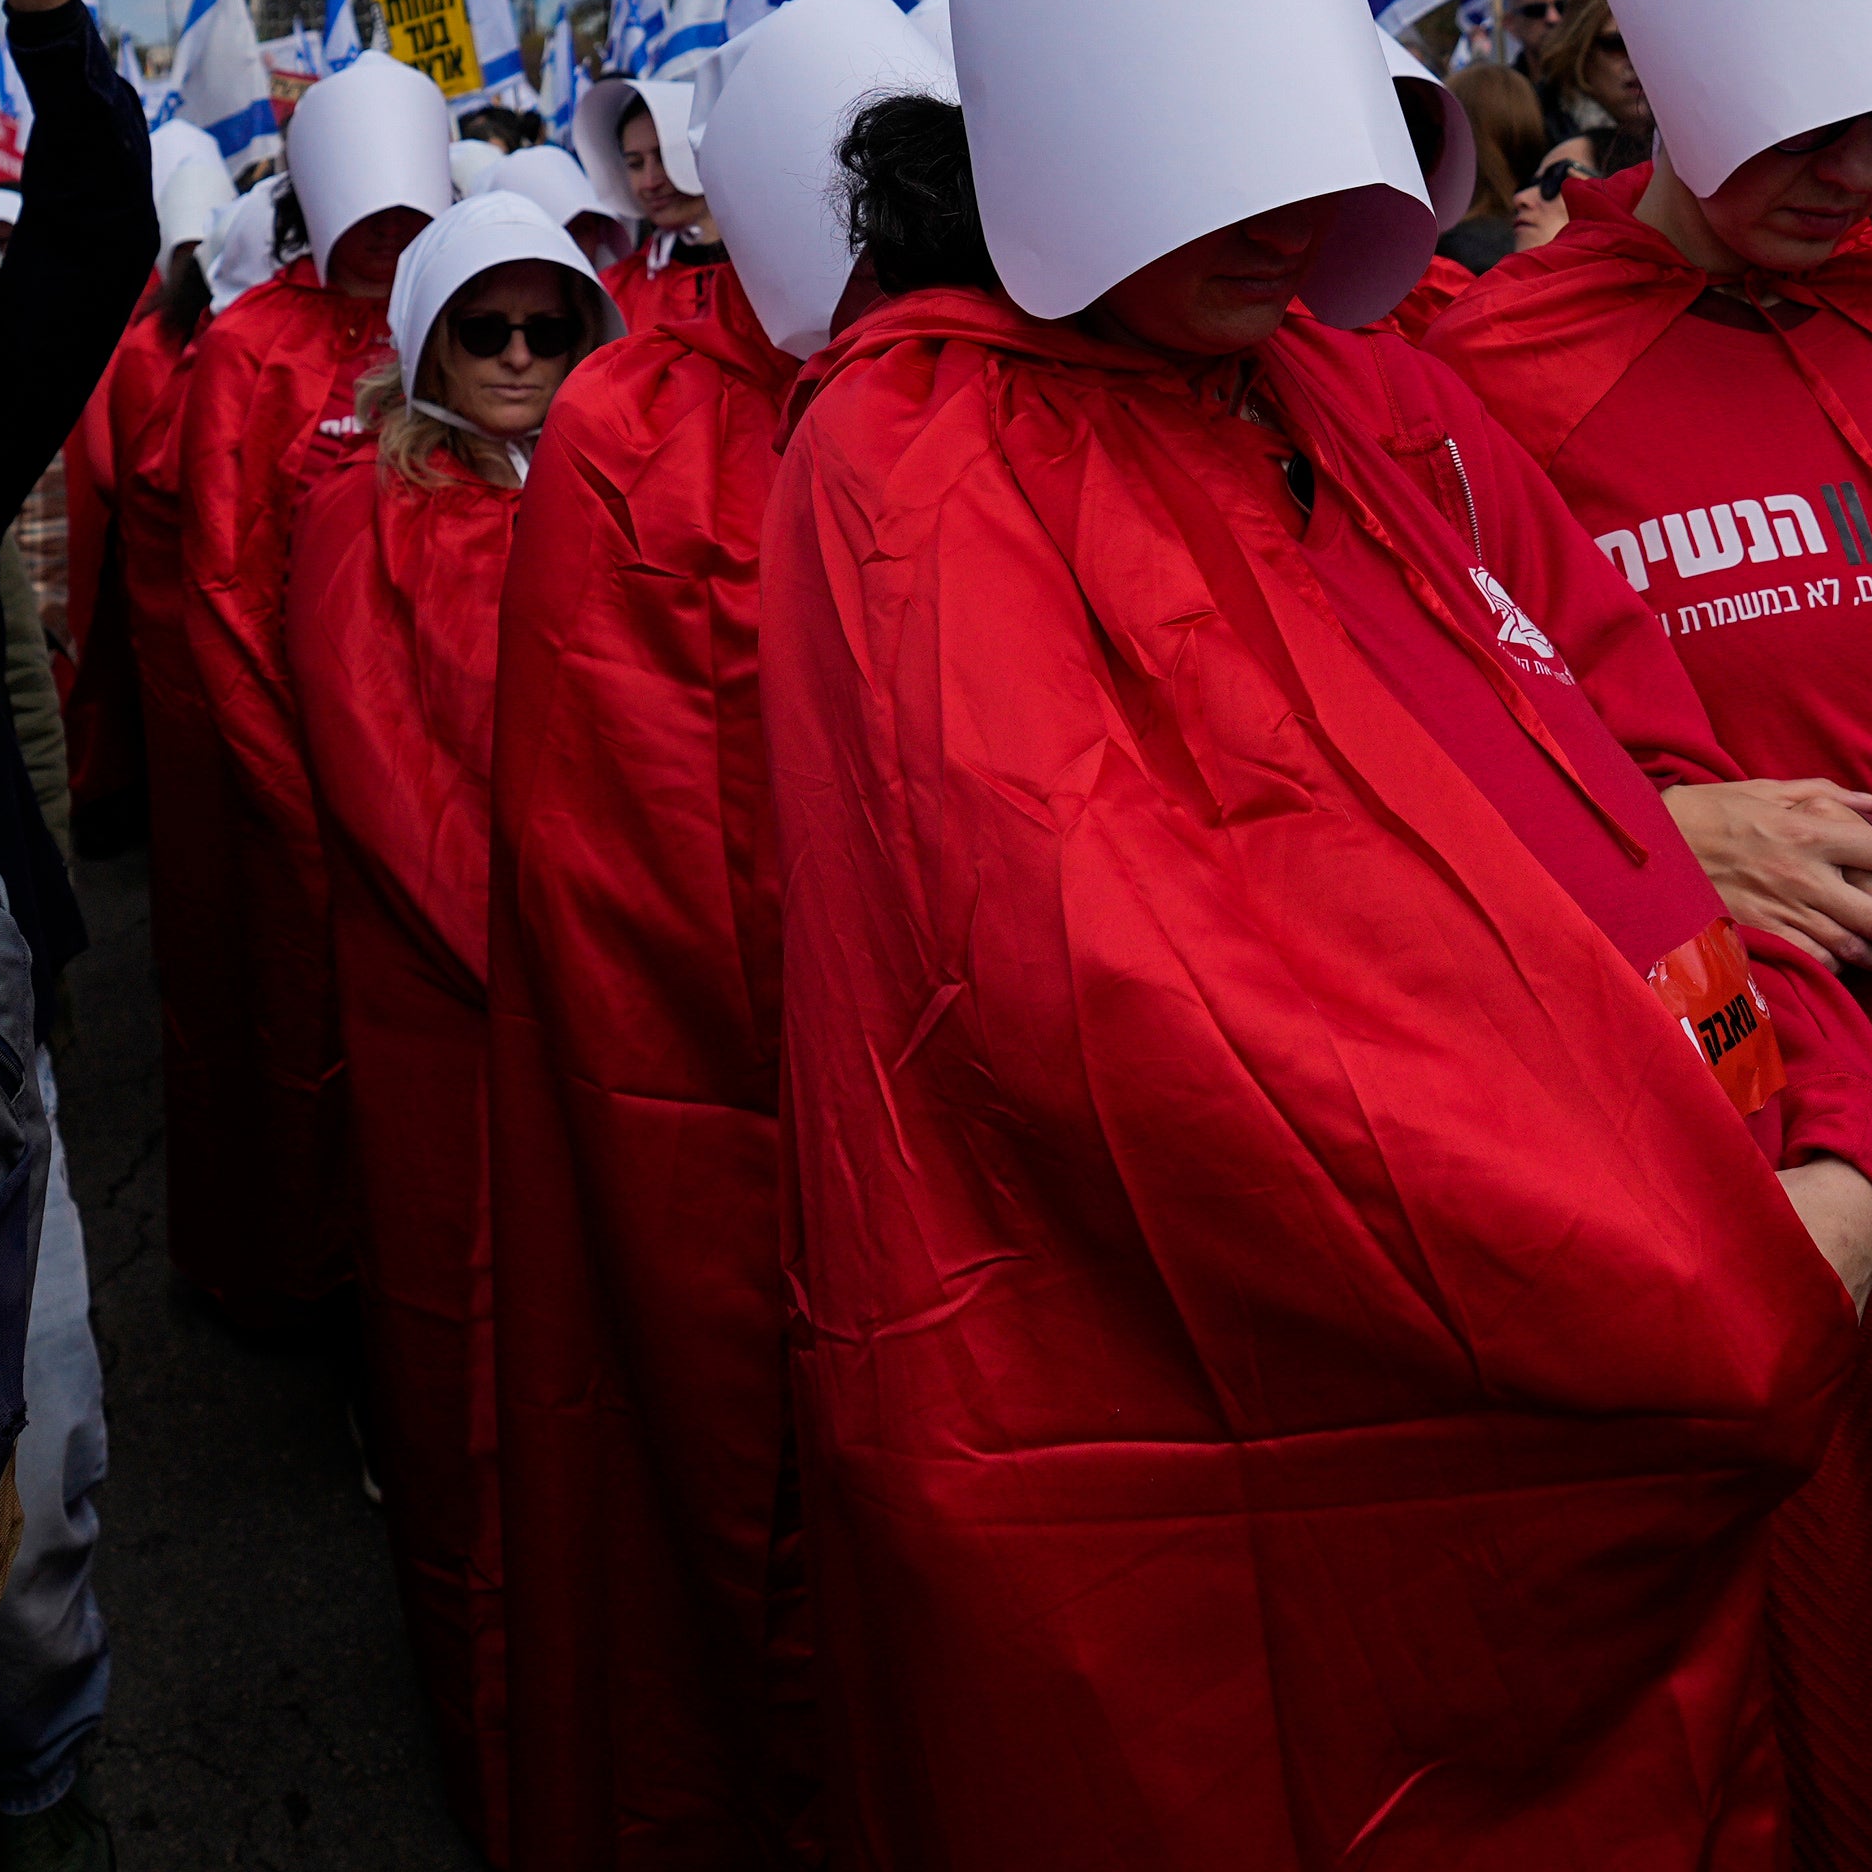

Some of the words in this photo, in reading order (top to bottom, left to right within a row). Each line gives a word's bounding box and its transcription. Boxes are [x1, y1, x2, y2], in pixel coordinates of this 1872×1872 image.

[404, 15, 451, 55] בעד
[410, 45, 464, 81] ארצ
[1679, 586, 1801, 635] במשמרת
[1807, 578, 1841, 608] לא
[1697, 993, 1758, 1067] מאבק
